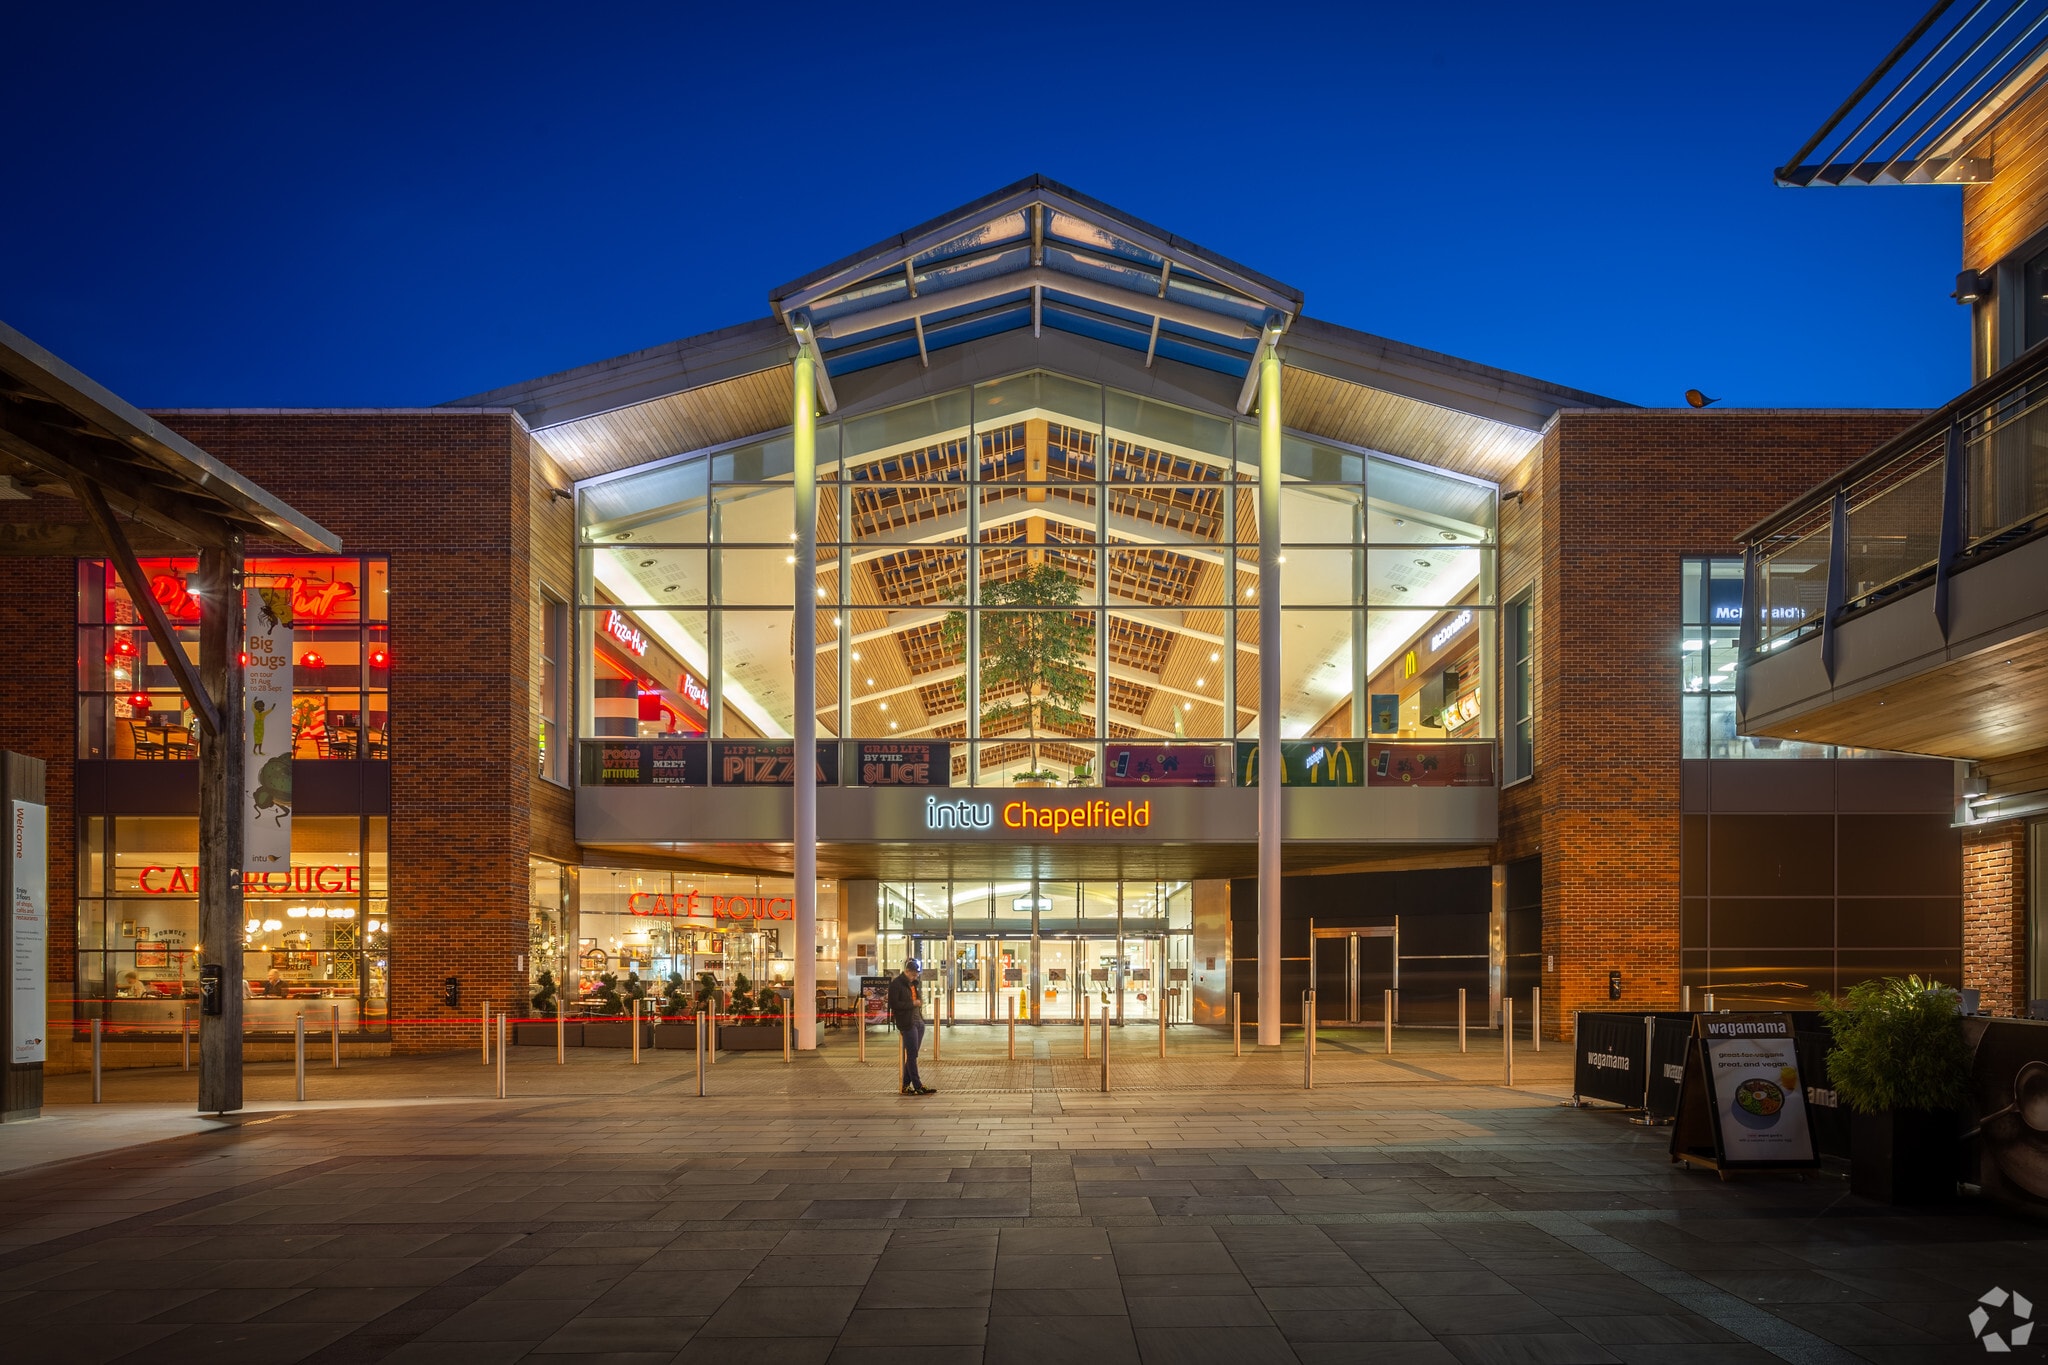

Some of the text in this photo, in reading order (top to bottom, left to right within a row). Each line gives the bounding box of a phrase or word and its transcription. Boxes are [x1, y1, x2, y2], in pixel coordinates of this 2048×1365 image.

[1715, 607, 1806, 619] Mcnald's
[607, 609, 648, 656] Pizza Hut
[250, 636, 273, 653] Big
[250, 652, 286, 670] bugs
[268, 685, 282, 693] Sept
[684, 674, 700, 701] Pizza
[602, 749, 641, 759] FOOD
[652, 745, 686, 760] EAT
[723, 746, 756, 755] LIFE
[863, 745, 930, 753] GRAB LIFE
[602, 759, 640, 769] WITH
[652, 760, 686, 768] MEET
[863, 754, 903, 762] BY THE
[602, 768, 640, 778] ATTITUDE
[652, 768, 686, 777] FEAST
[863, 763, 929, 784] SLICE
[927, 797, 1150, 834] intu Chapelfield
[16, 807, 24, 859] Welcome
[252, 854, 268, 862] intu
[138, 865, 361, 894] CA ROUGE
[628, 889, 795, 921] CAFÉ ROUG
[1707, 1022, 1787, 1036] wagamama
[1587, 1051, 1630, 1071] wagamama
